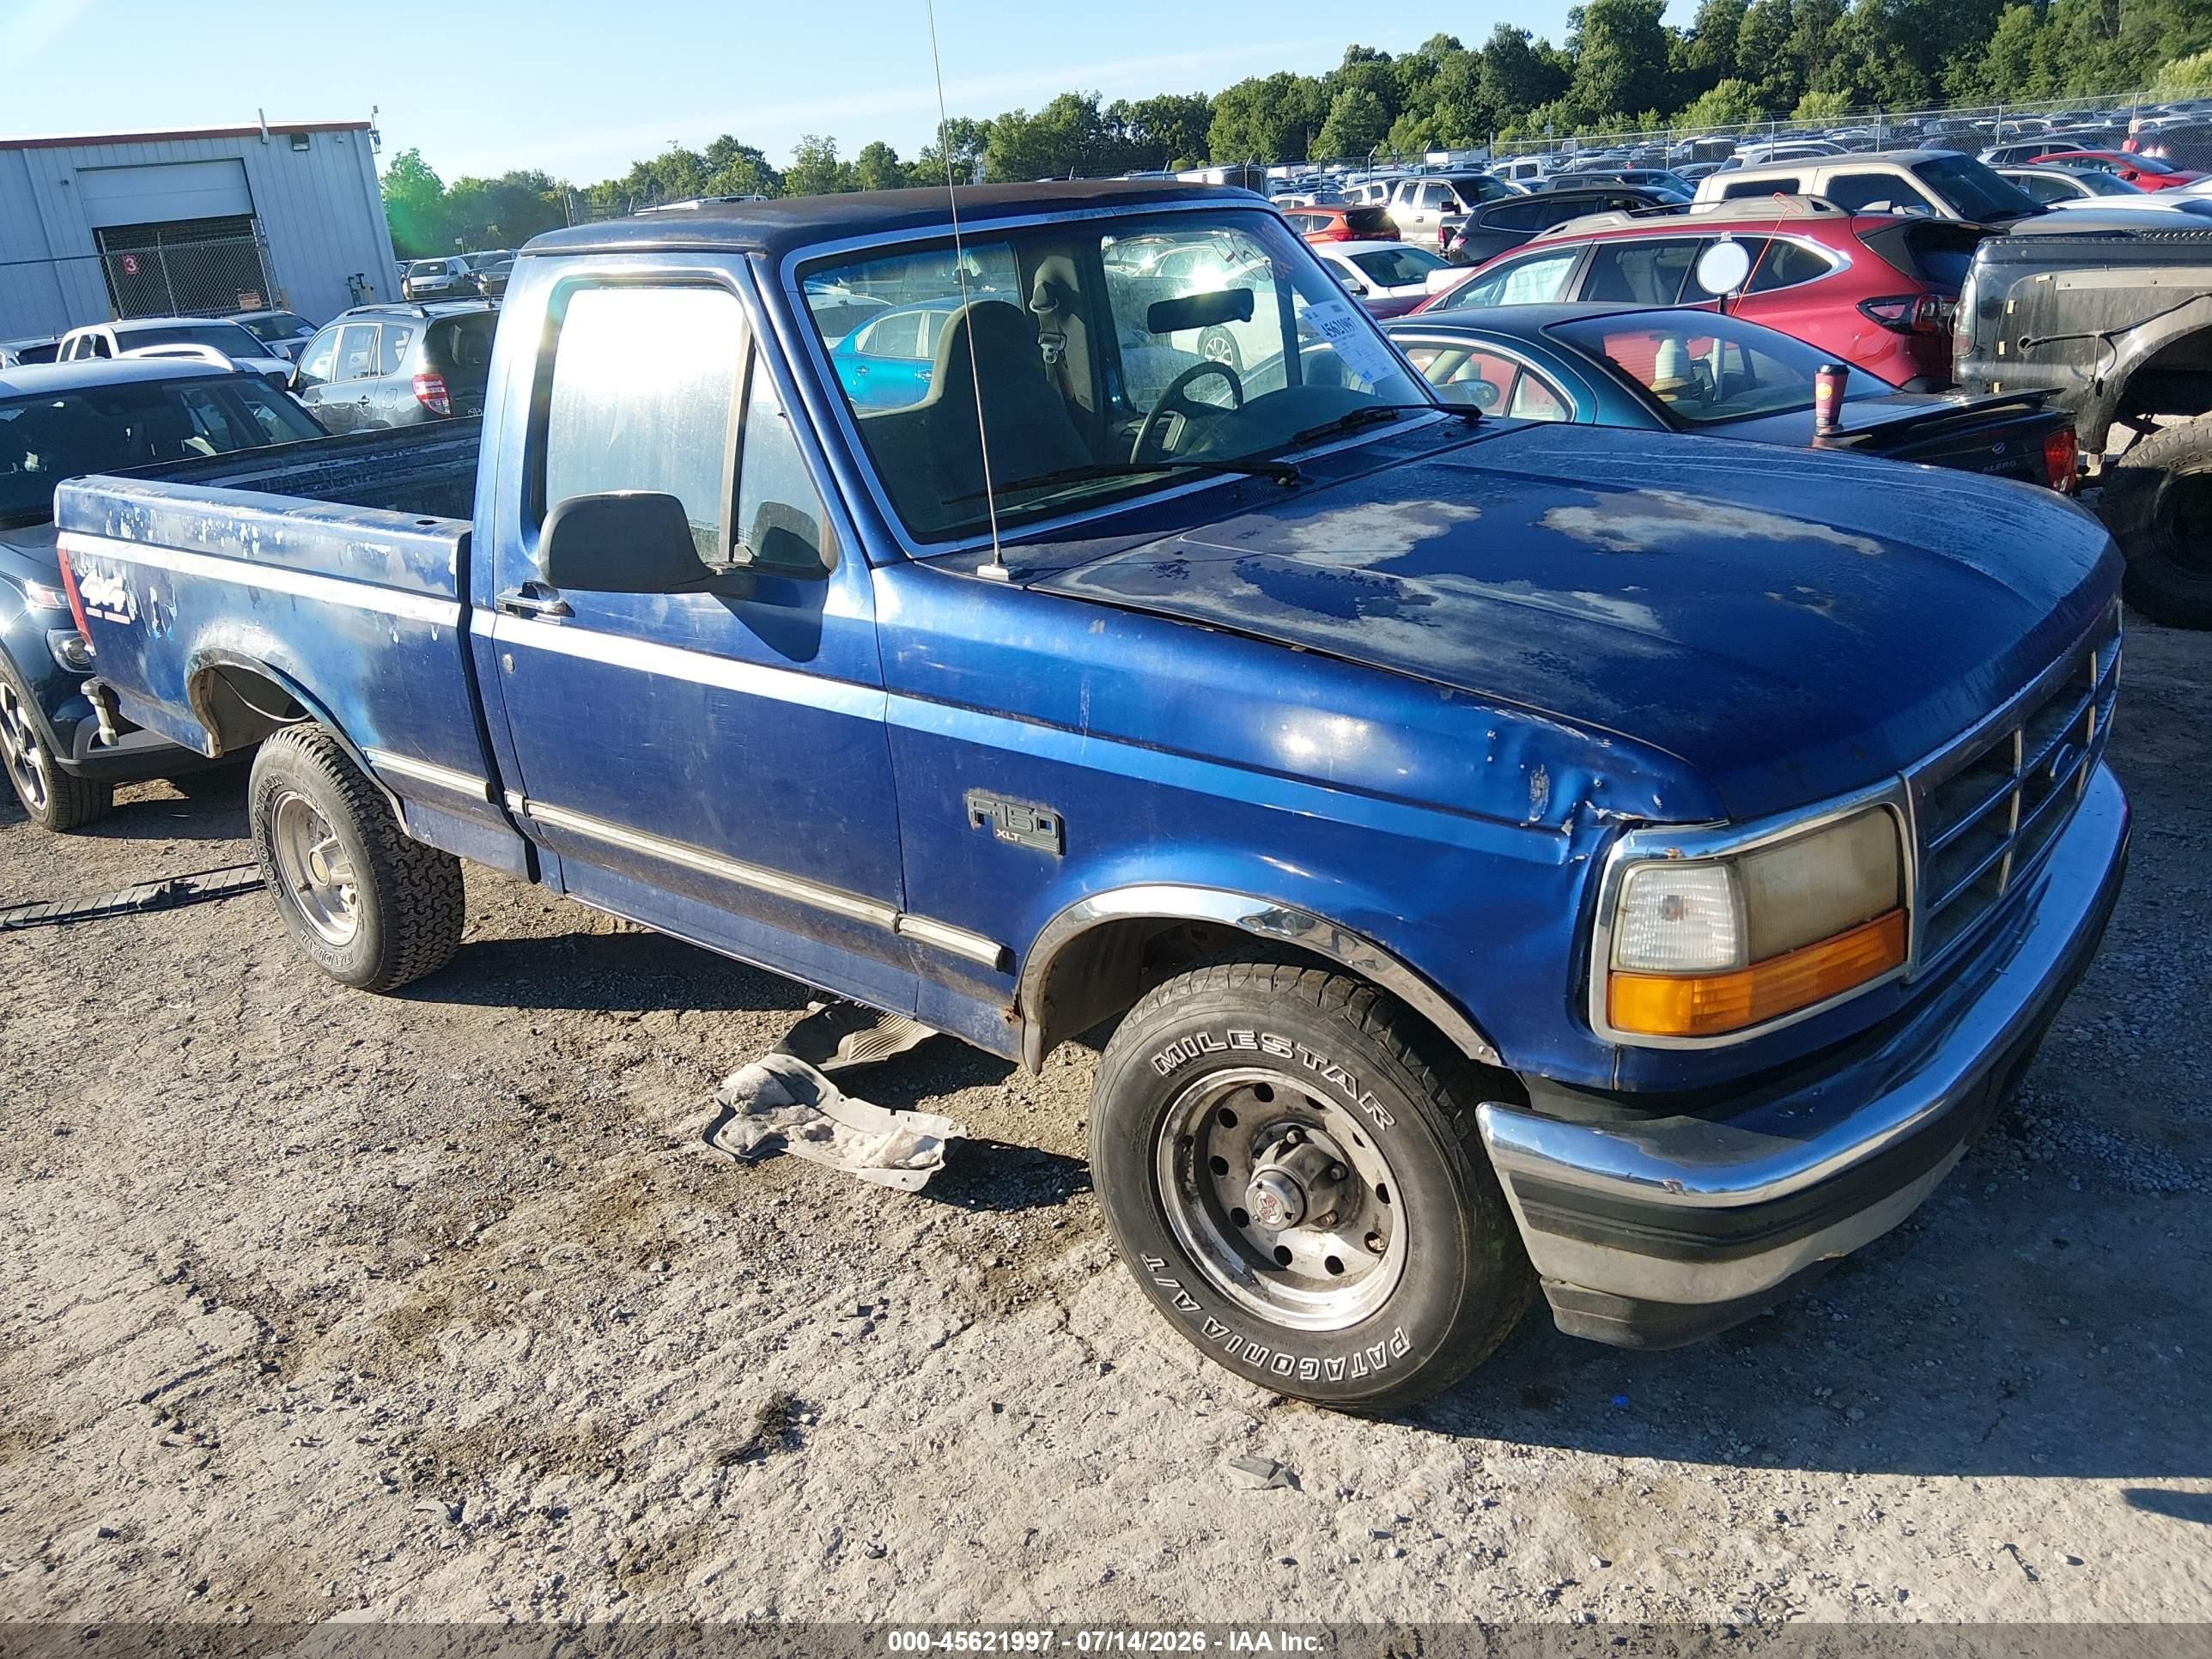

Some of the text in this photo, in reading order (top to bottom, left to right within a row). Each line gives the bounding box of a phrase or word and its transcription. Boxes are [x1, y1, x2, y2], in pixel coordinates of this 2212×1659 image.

[125, 258, 137, 272] 3
[1982, 459, 2017, 474] ALERO
[254, 773, 285, 899] GOODYEAR
[996, 829, 1021, 842] XLT
[300, 929, 354, 968] RADIAL
[1150, 1029, 1398, 1132] MILESTAR
[1139, 1252, 1205, 1314] A/T
[1200, 1314, 1413, 1383] PATAGONIA
